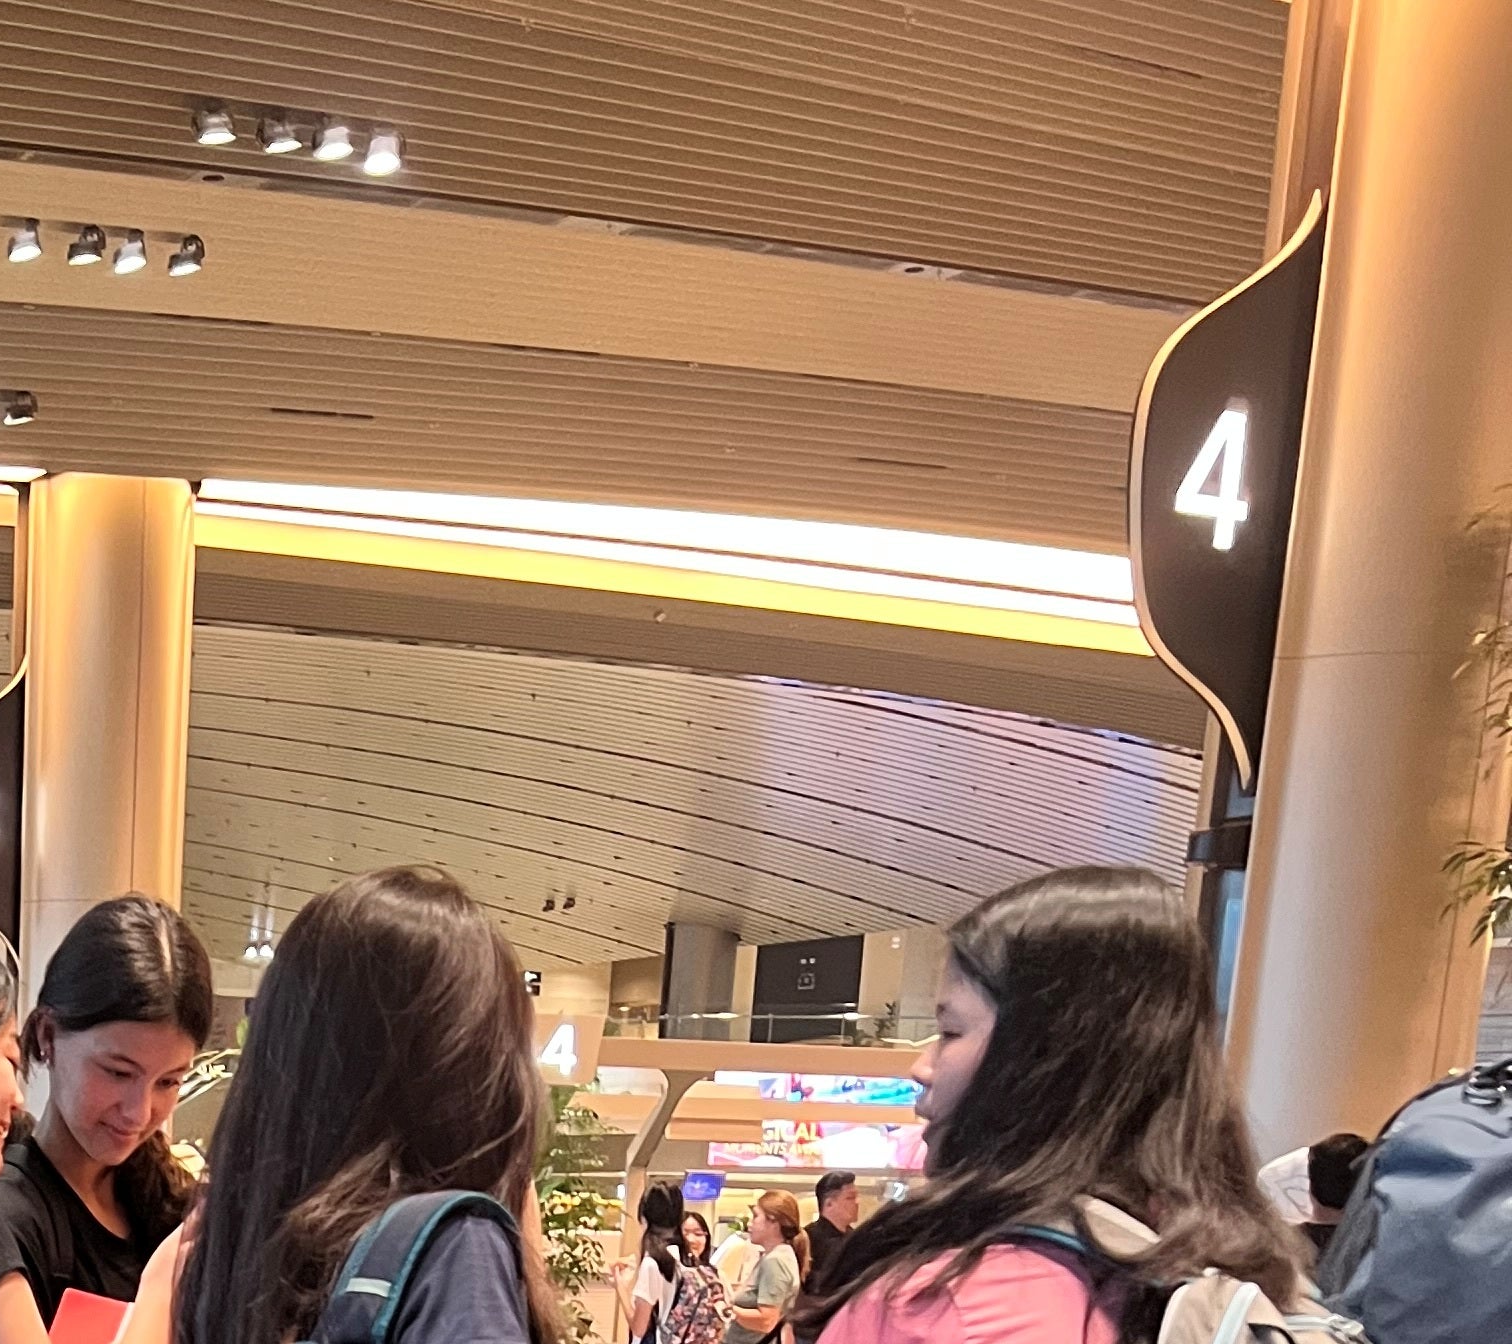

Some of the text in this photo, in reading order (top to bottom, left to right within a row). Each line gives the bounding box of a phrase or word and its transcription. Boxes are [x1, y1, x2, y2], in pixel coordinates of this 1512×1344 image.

[1174, 408, 1250, 551] 4
[537, 1023, 578, 1077] 4
[762, 1121, 820, 1141] GICAL
